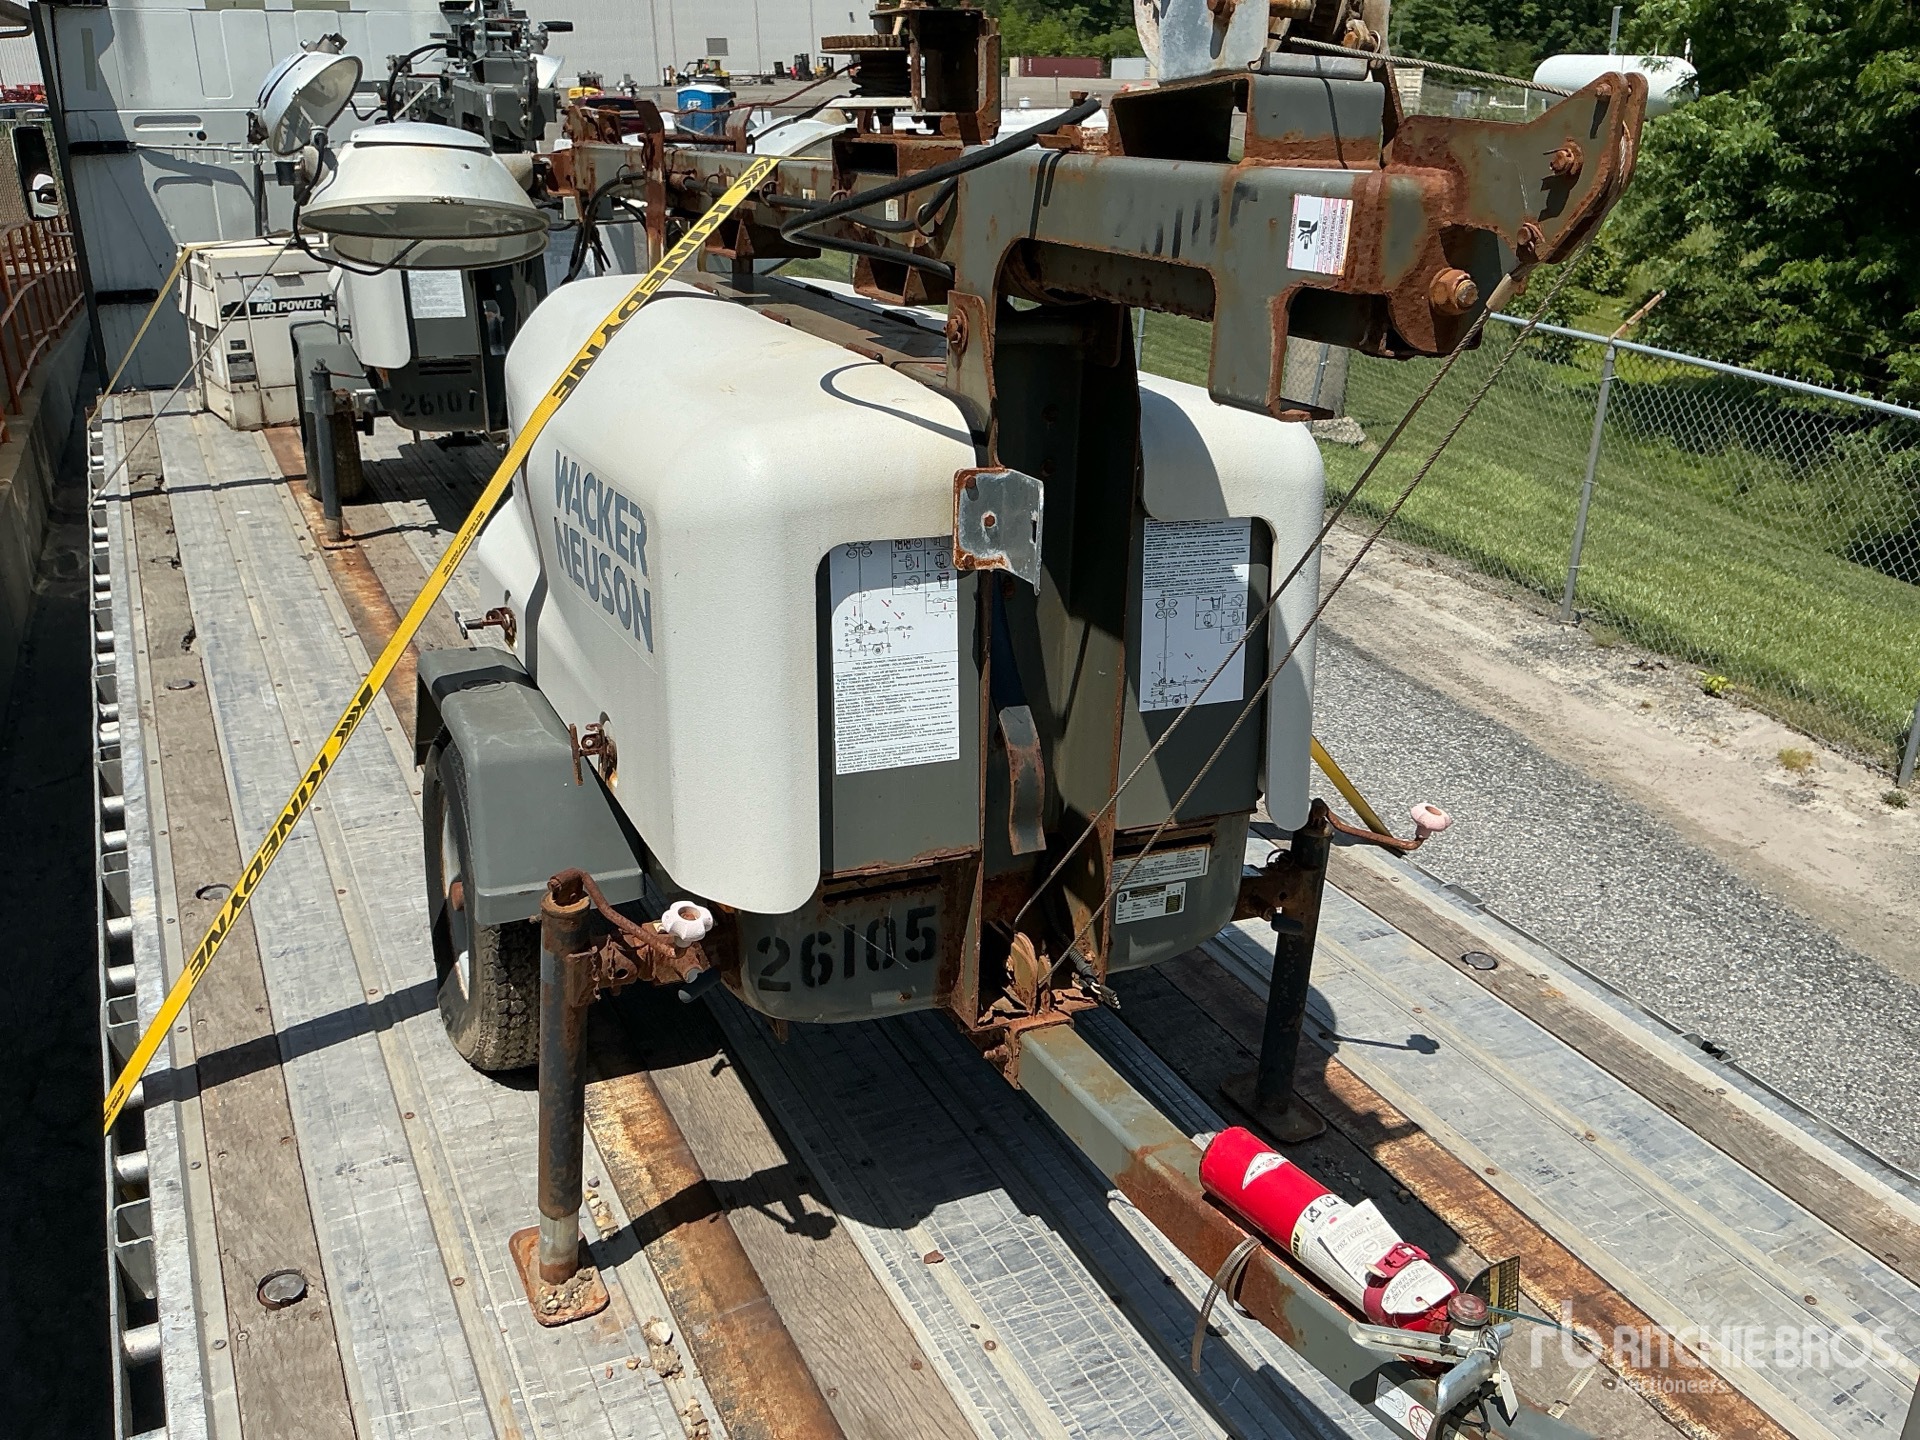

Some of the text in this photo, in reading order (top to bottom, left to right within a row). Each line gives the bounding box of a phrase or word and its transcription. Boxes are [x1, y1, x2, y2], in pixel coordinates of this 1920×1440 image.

[256, 299, 323, 313] MQ POWER
[552, 204, 732, 399] KINEDYNE
[554, 449, 649, 579] WACKER
[554, 516, 653, 653] NEUSON
[190, 753, 329, 985] KINEDYNE
[757, 905, 937, 992] 26105
